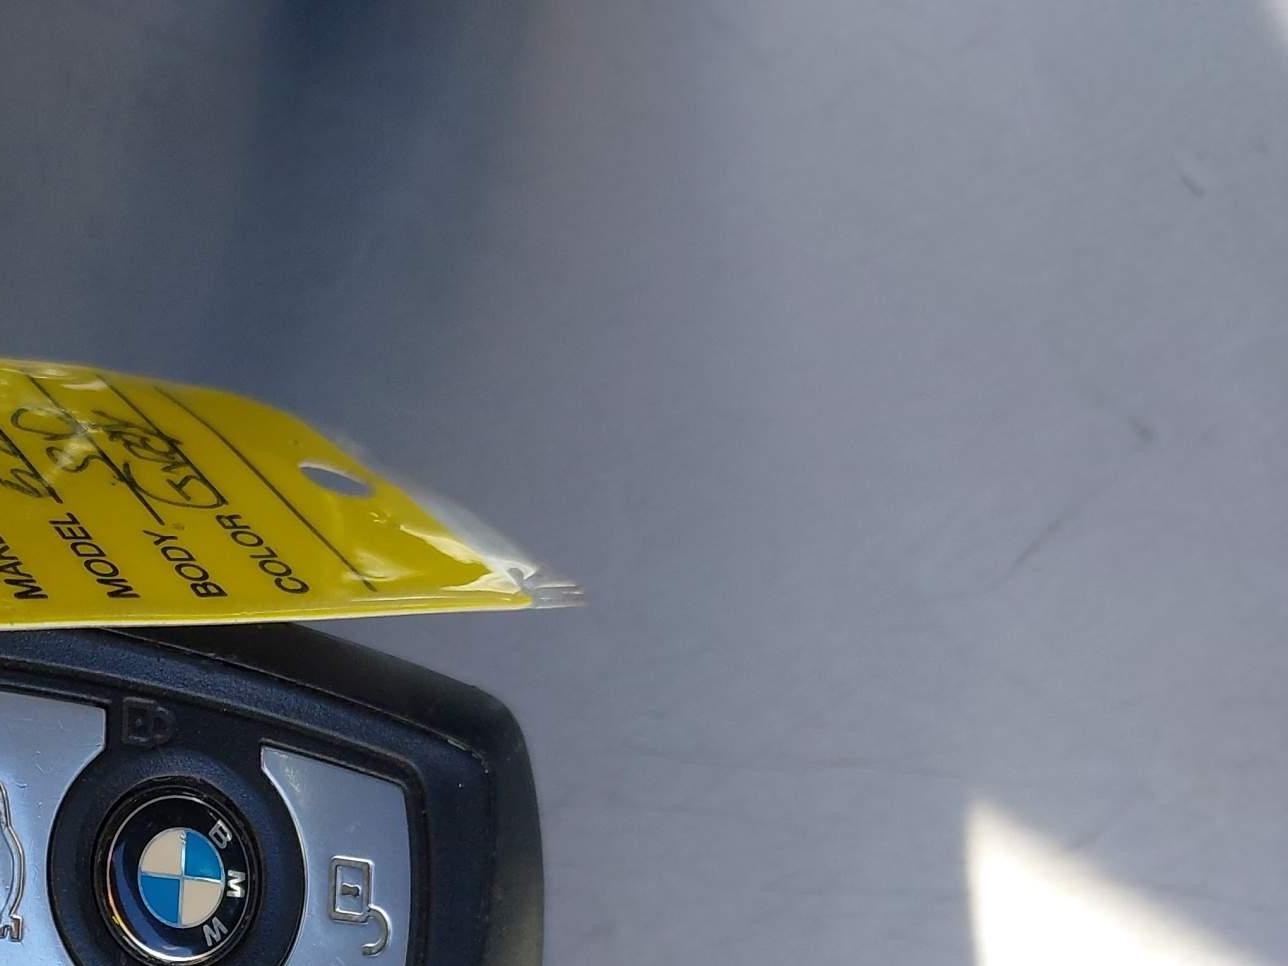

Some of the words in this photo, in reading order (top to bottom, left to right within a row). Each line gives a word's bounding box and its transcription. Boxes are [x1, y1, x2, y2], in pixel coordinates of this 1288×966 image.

[48, 511, 140, 600] MODEL
[143, 529, 228, 599] BODY
[215, 512, 311, 595] COLOR
[202, 819, 246, 947] BMW
